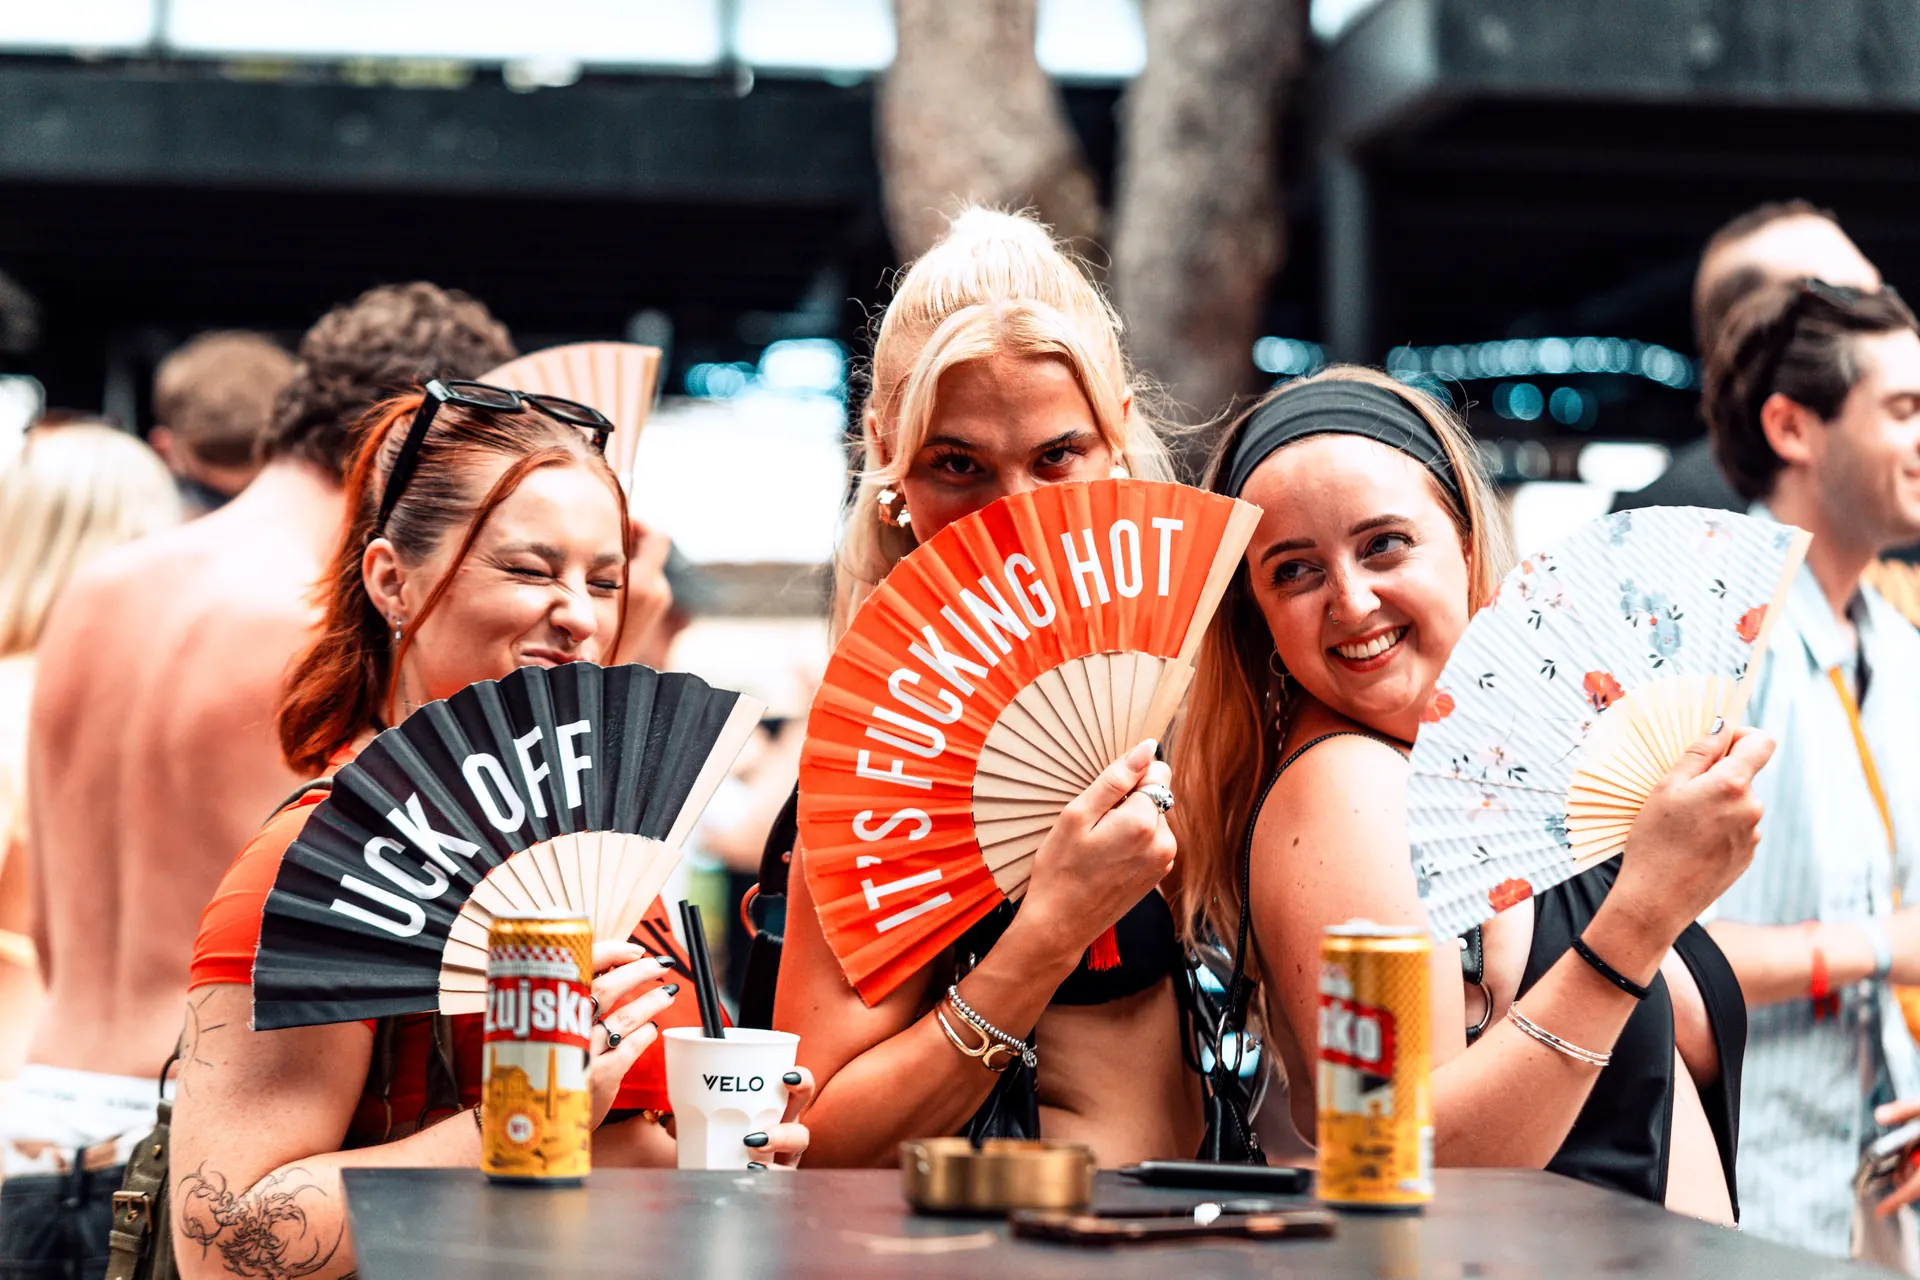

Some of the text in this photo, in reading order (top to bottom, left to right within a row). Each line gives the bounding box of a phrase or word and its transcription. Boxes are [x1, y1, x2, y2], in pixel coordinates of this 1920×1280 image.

[329, 719, 593, 938] UCK OFF
[852, 516, 1184, 933] IT'S FUCKING HOT
[702, 1073, 765, 1092] VELO
